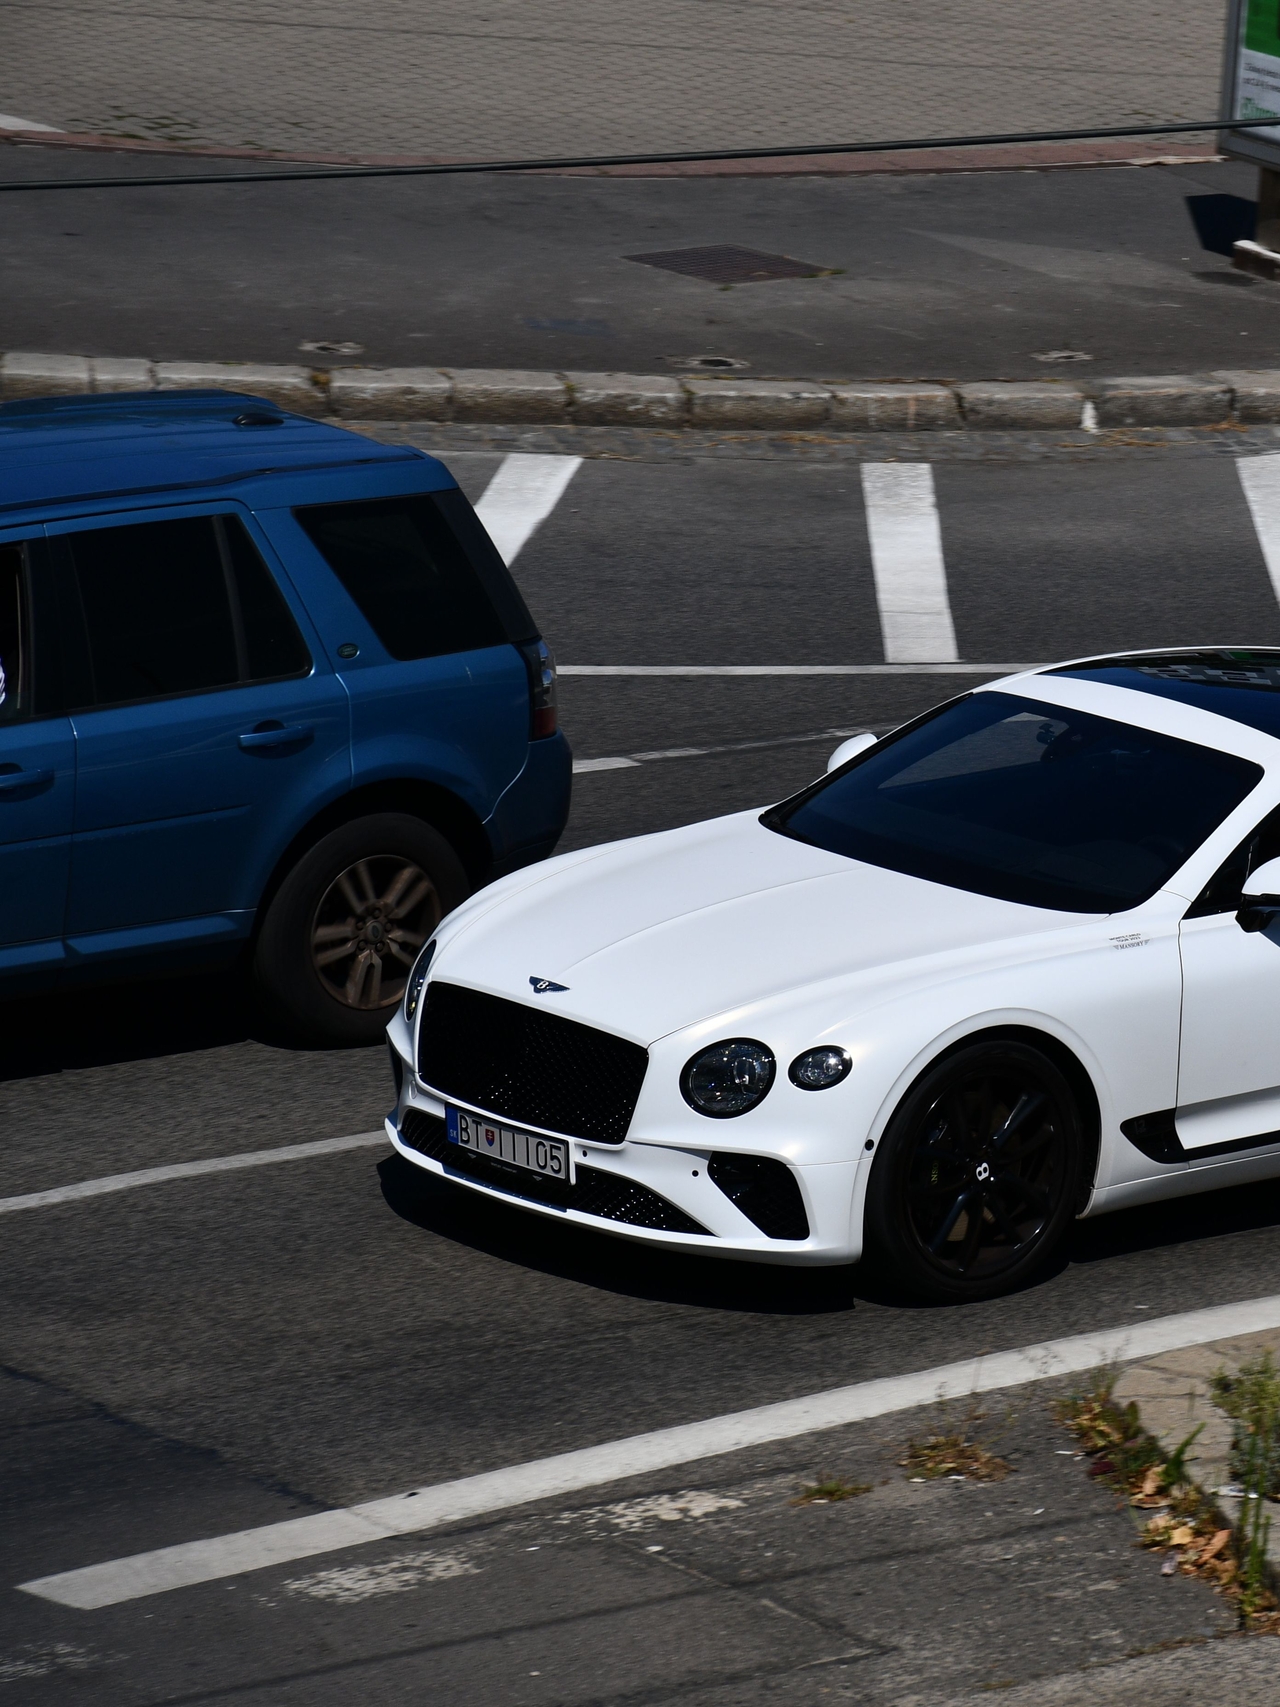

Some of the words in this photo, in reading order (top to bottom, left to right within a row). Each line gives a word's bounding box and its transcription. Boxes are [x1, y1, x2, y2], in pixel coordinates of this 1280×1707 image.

[1120, 940, 1144, 950] MANSORY
[449, 1128, 458, 1139] SK
[459, 1112, 482, 1150] BT
